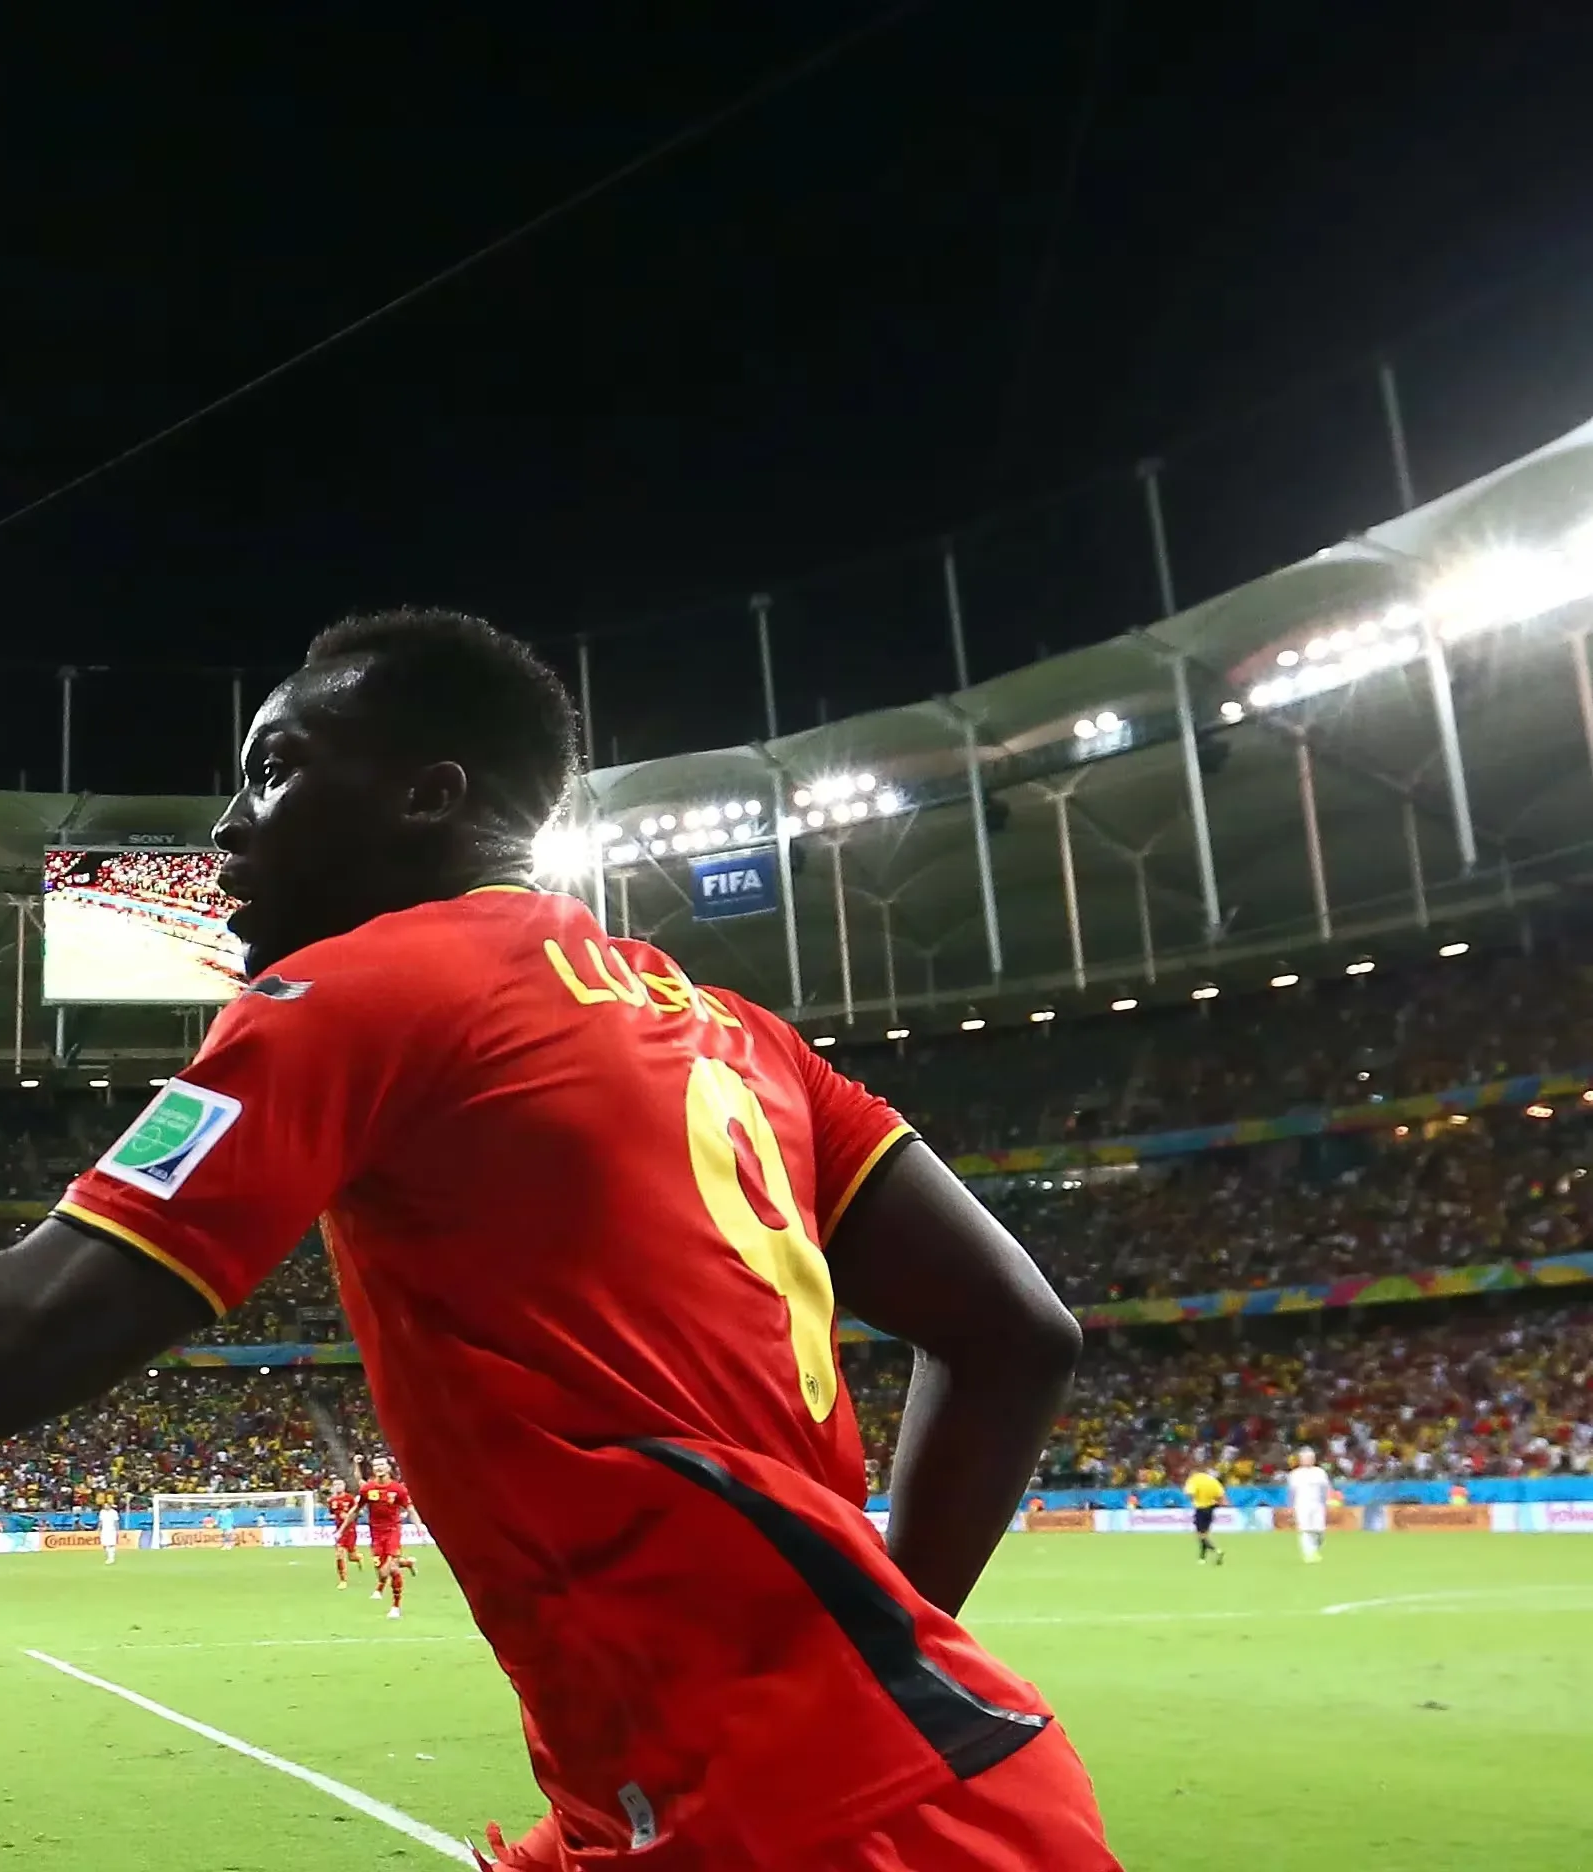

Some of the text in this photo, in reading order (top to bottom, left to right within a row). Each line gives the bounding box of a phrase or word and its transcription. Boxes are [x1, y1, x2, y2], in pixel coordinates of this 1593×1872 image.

[127, 834, 175, 845] SONY
[702, 869, 763, 897] FIFA
[686, 1057, 838, 1424] 9
[44, 1534, 103, 1549] Continen
